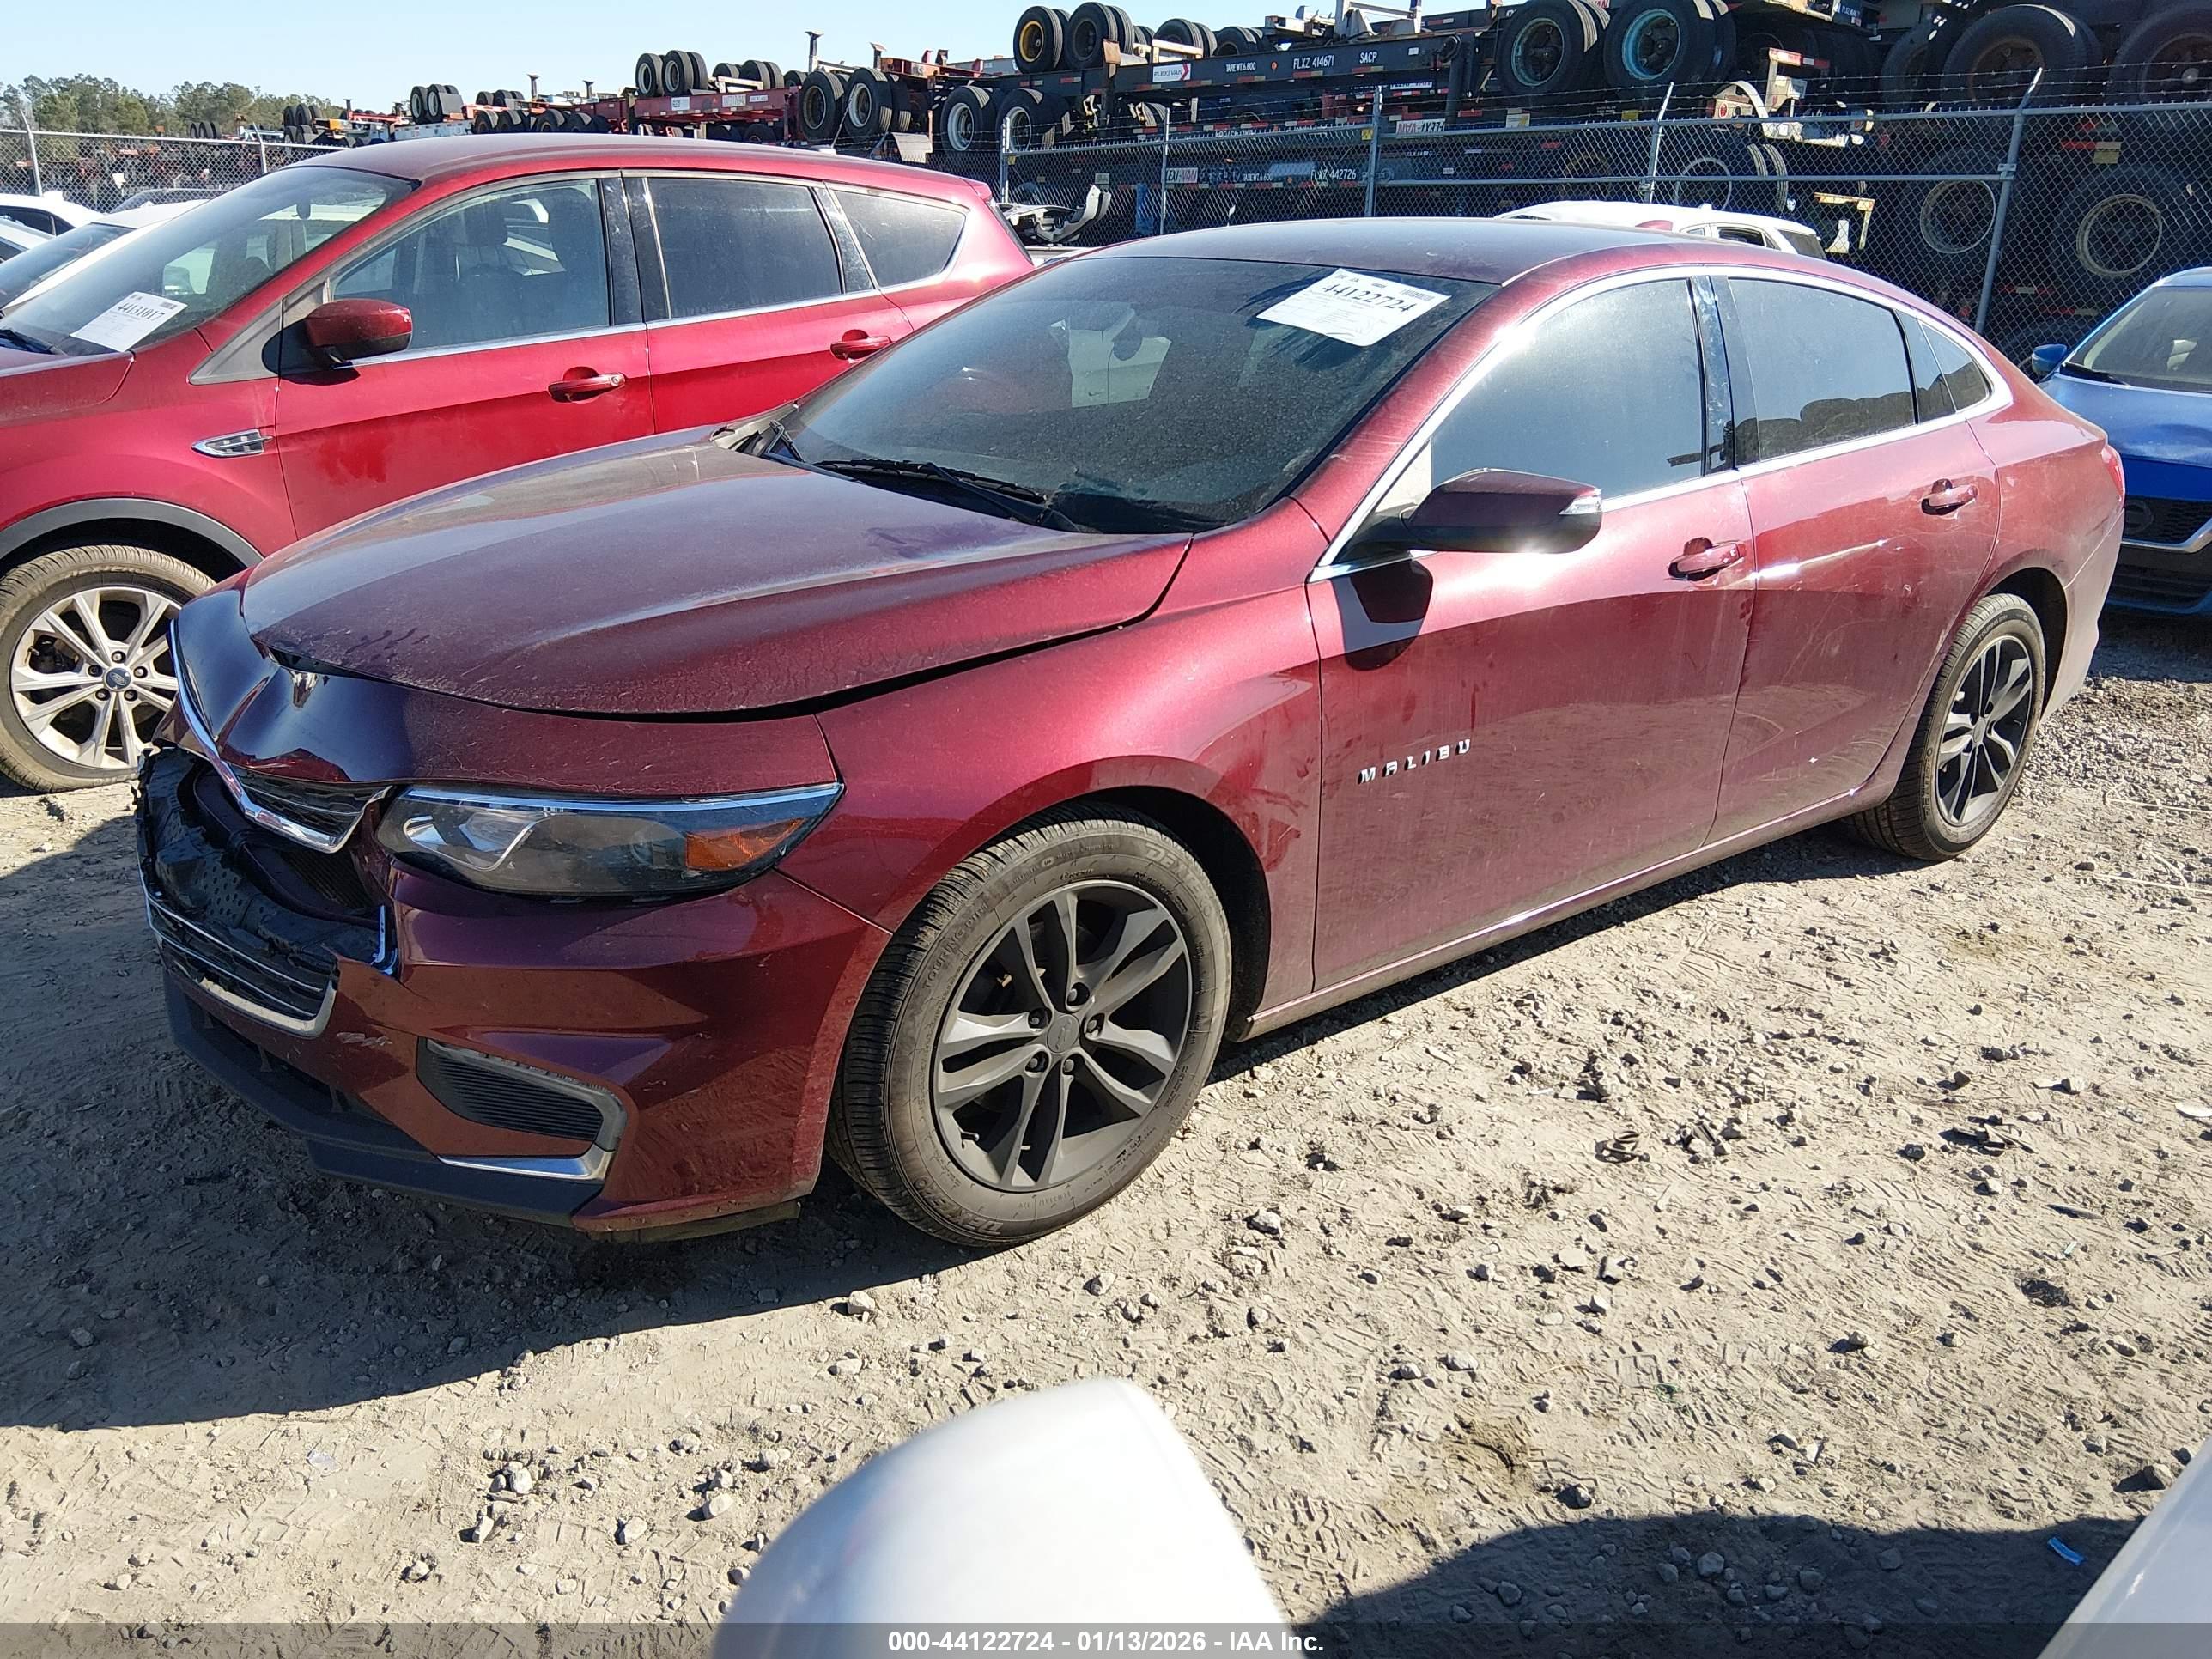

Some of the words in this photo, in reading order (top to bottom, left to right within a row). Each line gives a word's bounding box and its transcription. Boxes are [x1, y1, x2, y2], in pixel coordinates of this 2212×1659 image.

[1293, 57, 1310, 70] FLXZ
[1311, 54, 1334, 68] 414671
[1359, 52, 1378, 64] SACP
[1329, 168, 1357, 180] 442726
[1322, 283, 1417, 313] 44122724
[117, 302, 166, 322] 44131017
[1357, 738, 1471, 785] MALIBU
[921, 927, 963, 989] TOURING
